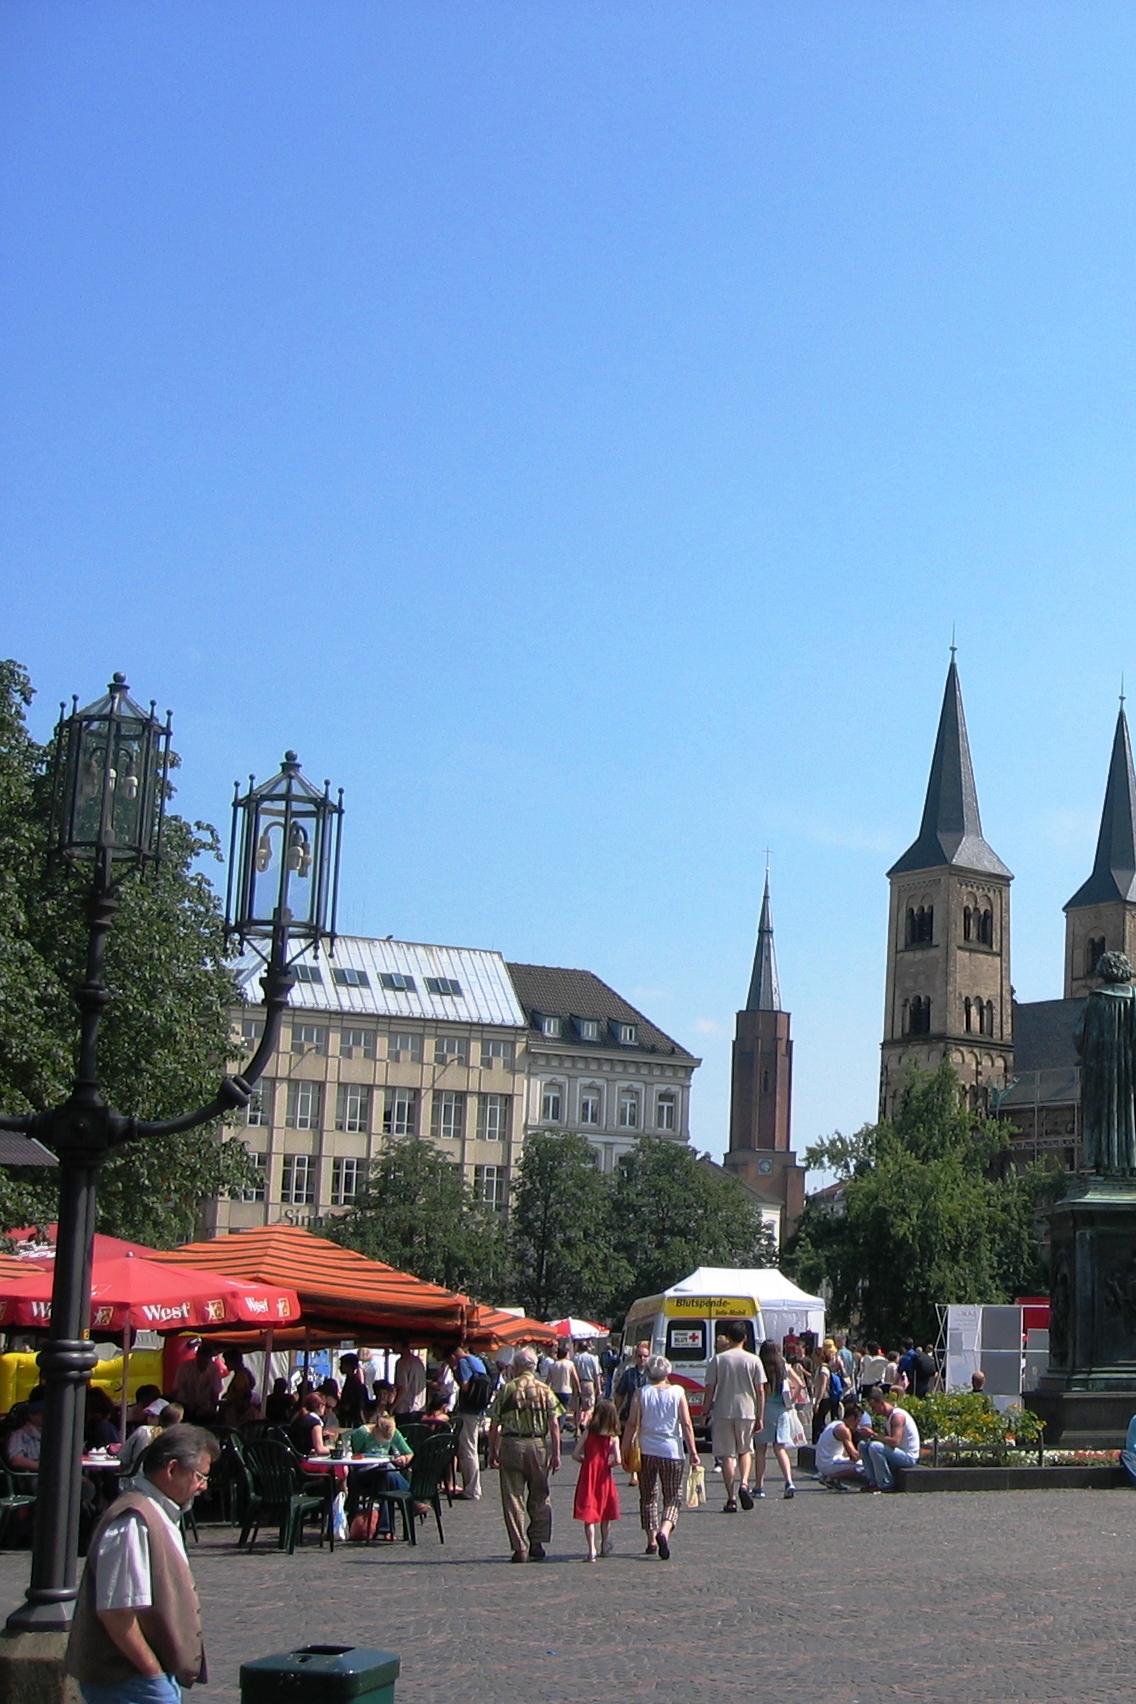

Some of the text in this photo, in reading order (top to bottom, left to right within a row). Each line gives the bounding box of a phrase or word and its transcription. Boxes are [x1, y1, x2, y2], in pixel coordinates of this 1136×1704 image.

[141, 1301, 191, 1324] West
[244, 1296, 270, 1315] West
[676, 1298, 731, 1309] Blutspende-
